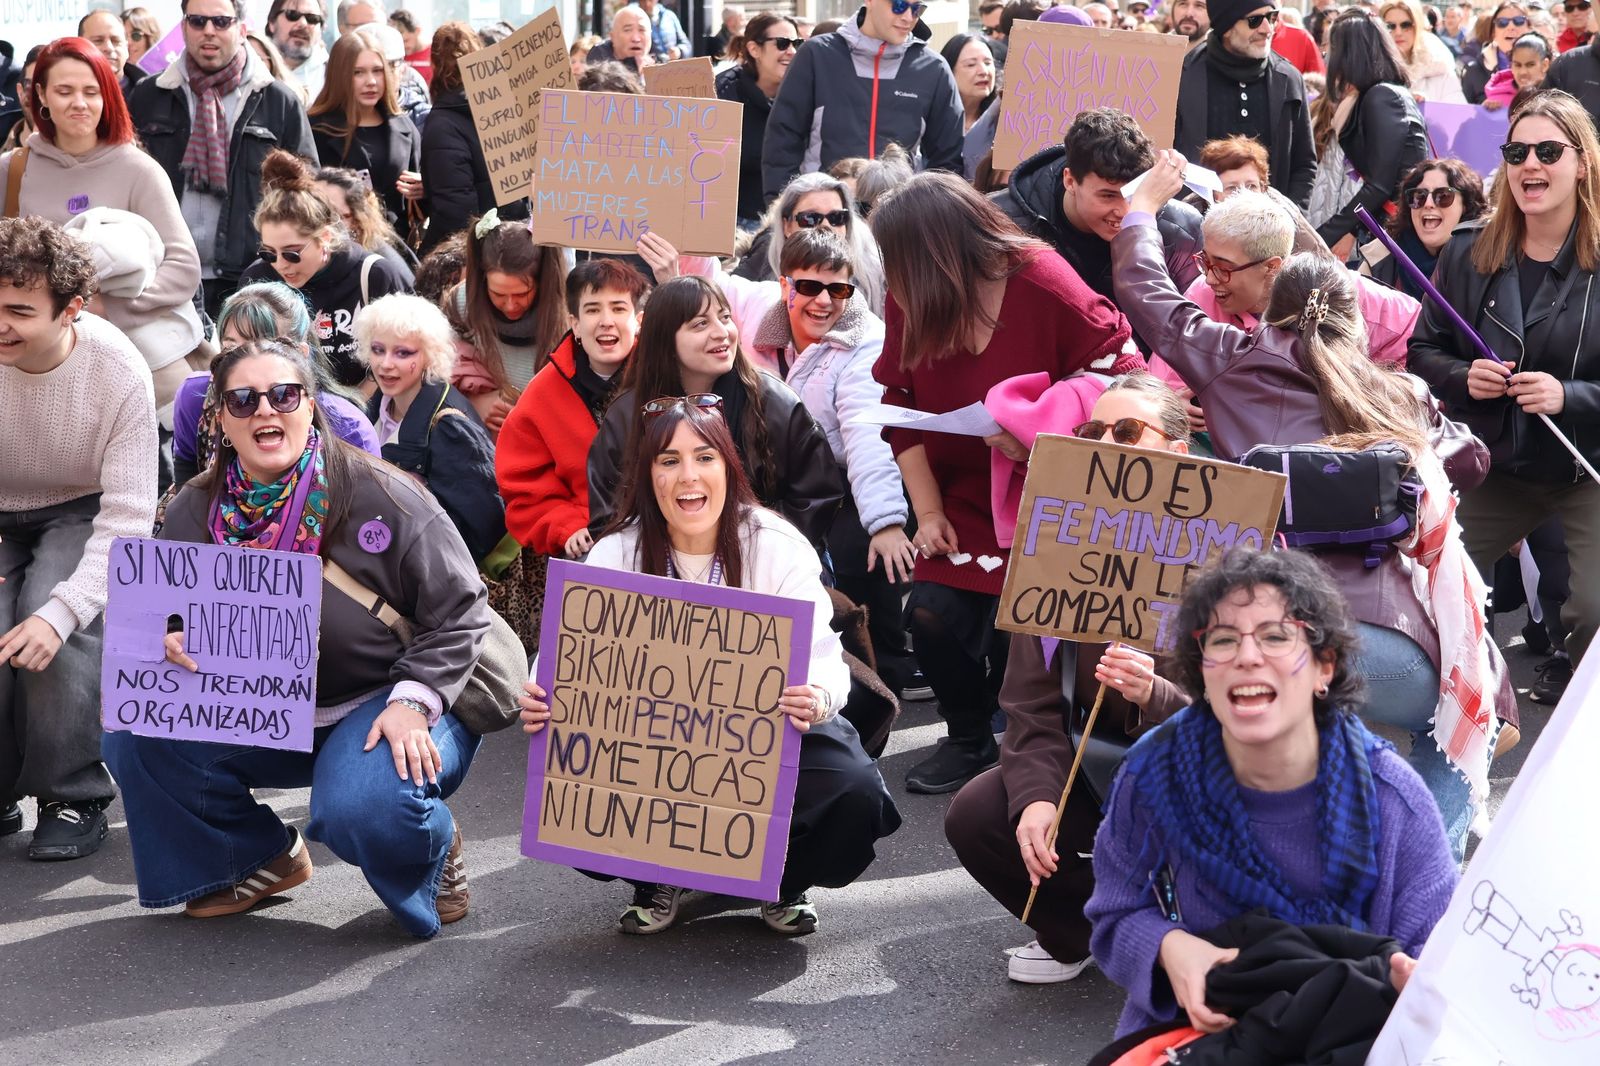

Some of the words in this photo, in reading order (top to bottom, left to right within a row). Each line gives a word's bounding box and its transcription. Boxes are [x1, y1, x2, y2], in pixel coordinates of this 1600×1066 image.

[466, 50, 512, 81] TODAS
[511, 21, 561, 62] TENEMOS
[1023, 40, 1108, 88] QUIÉN
[1116, 55, 1161, 93] NO
[473, 86, 501, 105] UNA
[510, 65, 538, 90] AMIGA
[544, 48, 566, 69] QUE
[479, 95, 523, 131] SUFRIÓ
[543, 93, 576, 124] EL
[585, 95, 719, 130] MACHISMO
[1014, 80, 1040, 115] SE
[1123, 95, 1161, 122] NO
[484, 118, 531, 152] NINGUNO
[543, 129, 674, 159] TAMBIÉN
[488, 158, 505, 173] UN
[500, 174, 518, 191] NO
[541, 157, 614, 185] MATA
[625, 163, 640, 185] A
[649, 165, 685, 186] LAS
[538, 191, 650, 218] MUJERES
[563, 215, 650, 241] TRANS
[1085, 451, 1153, 502] NO
[1163, 462, 1218, 519] ES
[364, 529, 386, 545] 8M
[1023, 496, 1263, 566] FEMINISMO
[156, 545, 198, 589] NOS
[1069, 551, 1138, 592] SIN
[187, 602, 312, 670] ENFRENTADAS
[117, 669, 180, 693] NOS
[195, 671, 312, 702] TRENDRÁN
[548, 727, 591, 776] NO
[590, 737, 643, 786] ME
[646, 745, 766, 806] TOCAS
[584, 788, 644, 839] UN
[646, 797, 755, 860] PELO
